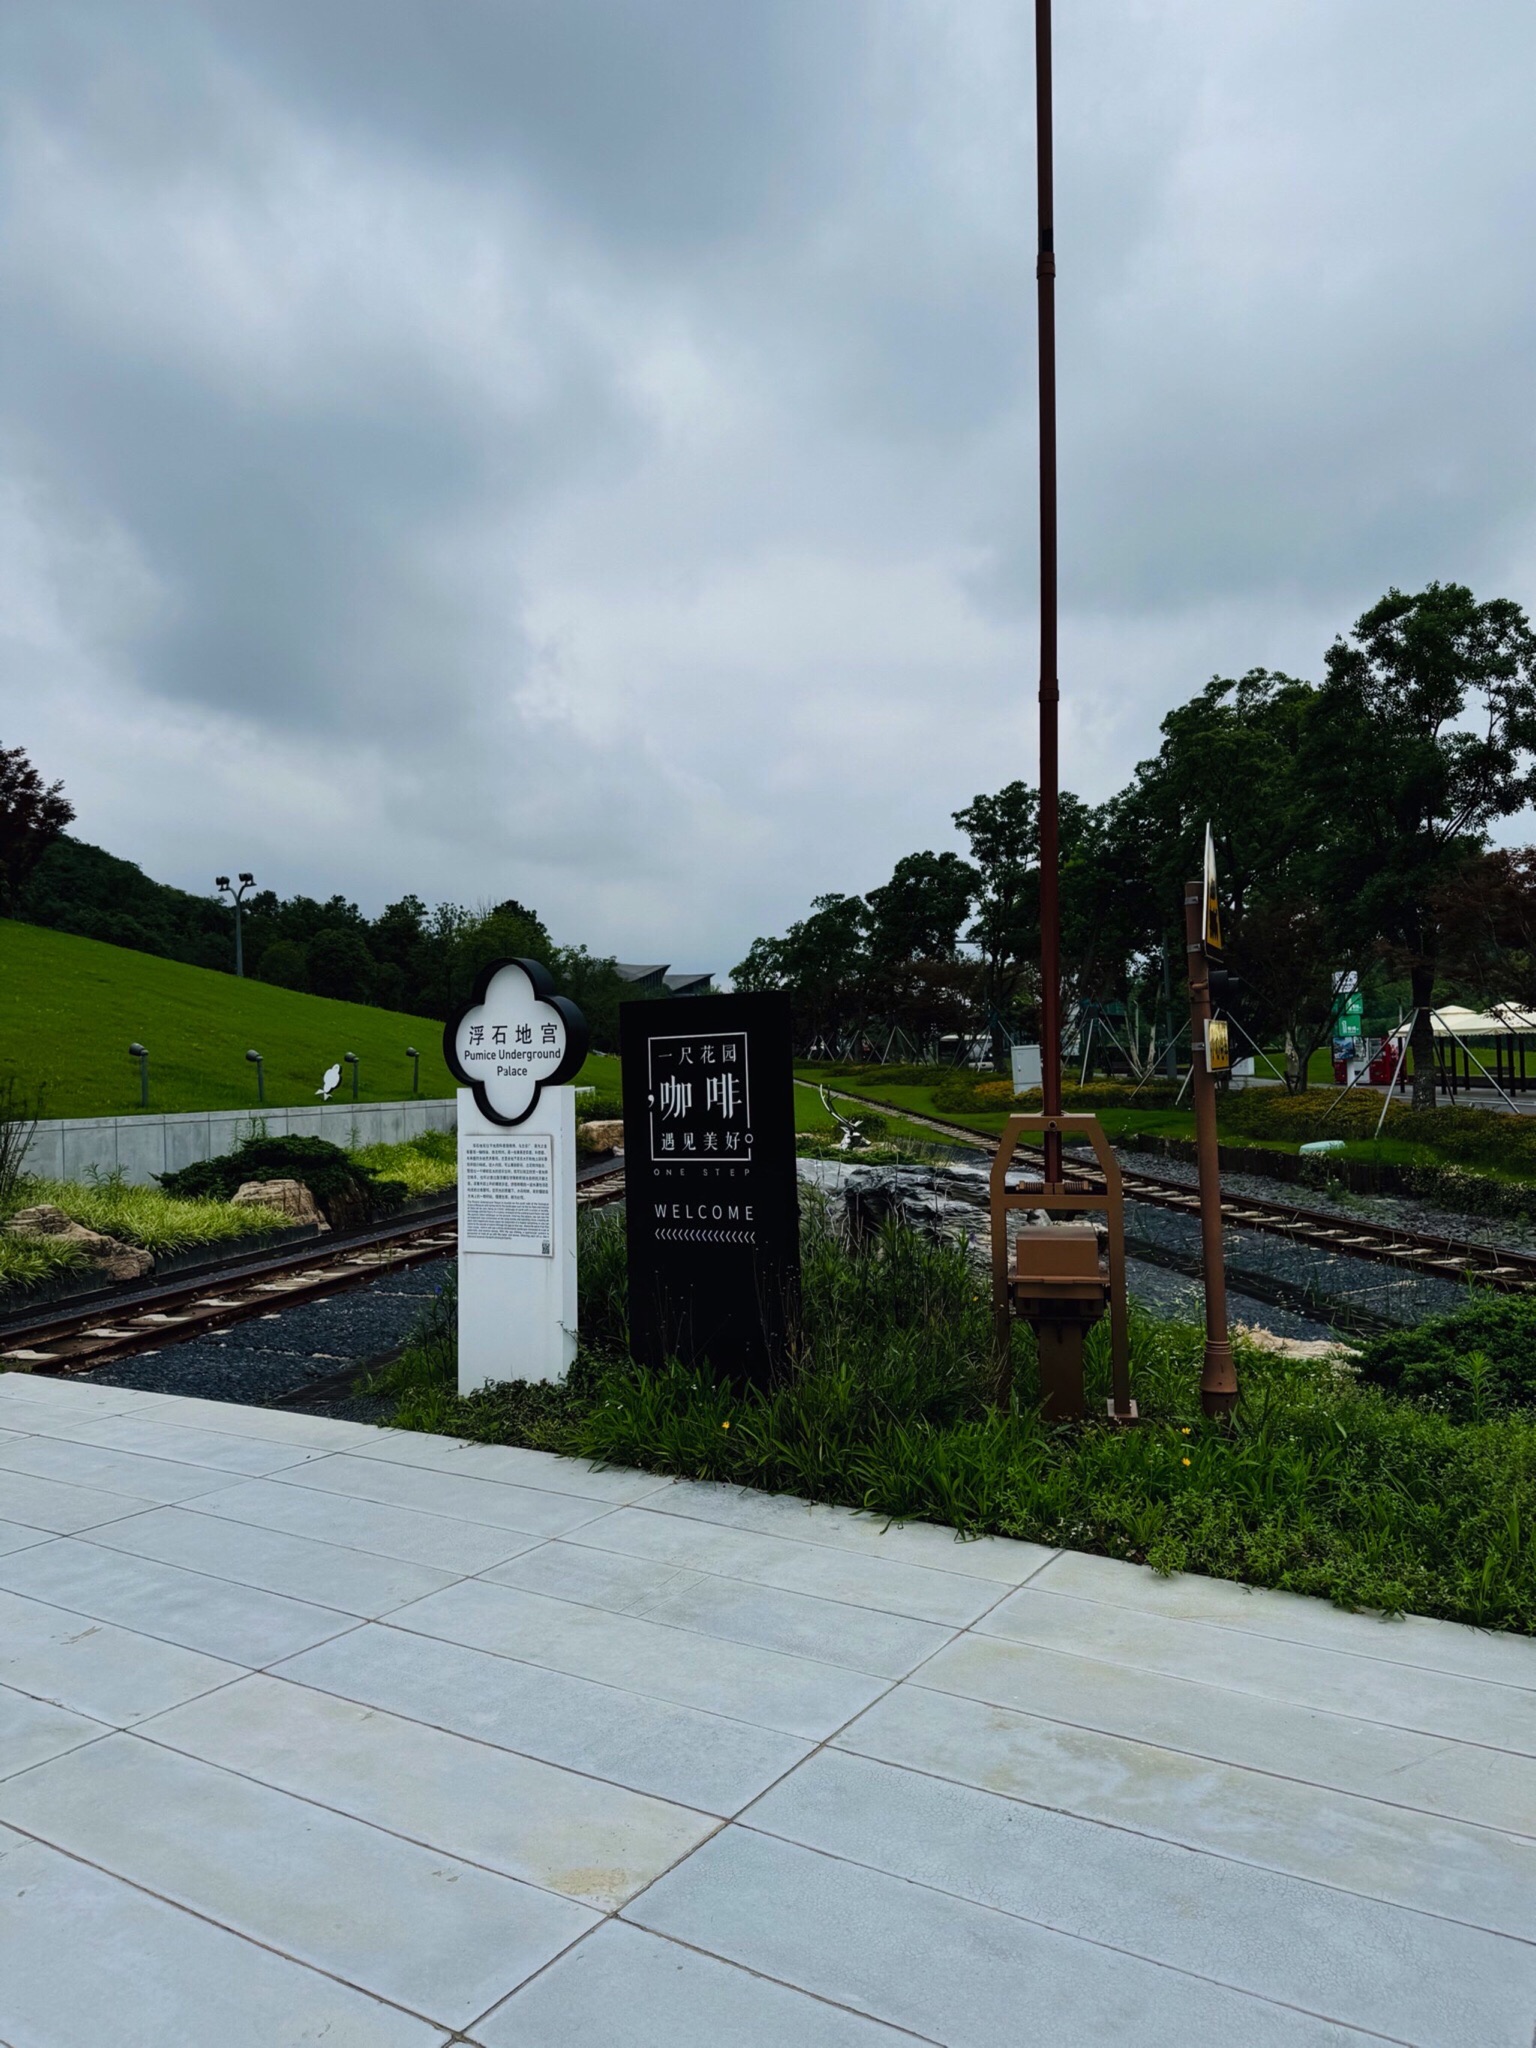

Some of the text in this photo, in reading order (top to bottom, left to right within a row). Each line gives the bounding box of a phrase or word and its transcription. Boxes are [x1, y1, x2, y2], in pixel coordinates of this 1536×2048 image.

[468, 1022, 558, 1047] 浮石地宫
[464, 1048, 561, 1062] Pumice Underground
[657, 1043, 737, 1066] 一尺花园
[496, 1065, 528, 1077] Palace
[653, 1167, 750, 1178] ONE STEP
[654, 1203, 754, 1221] WELCOME
